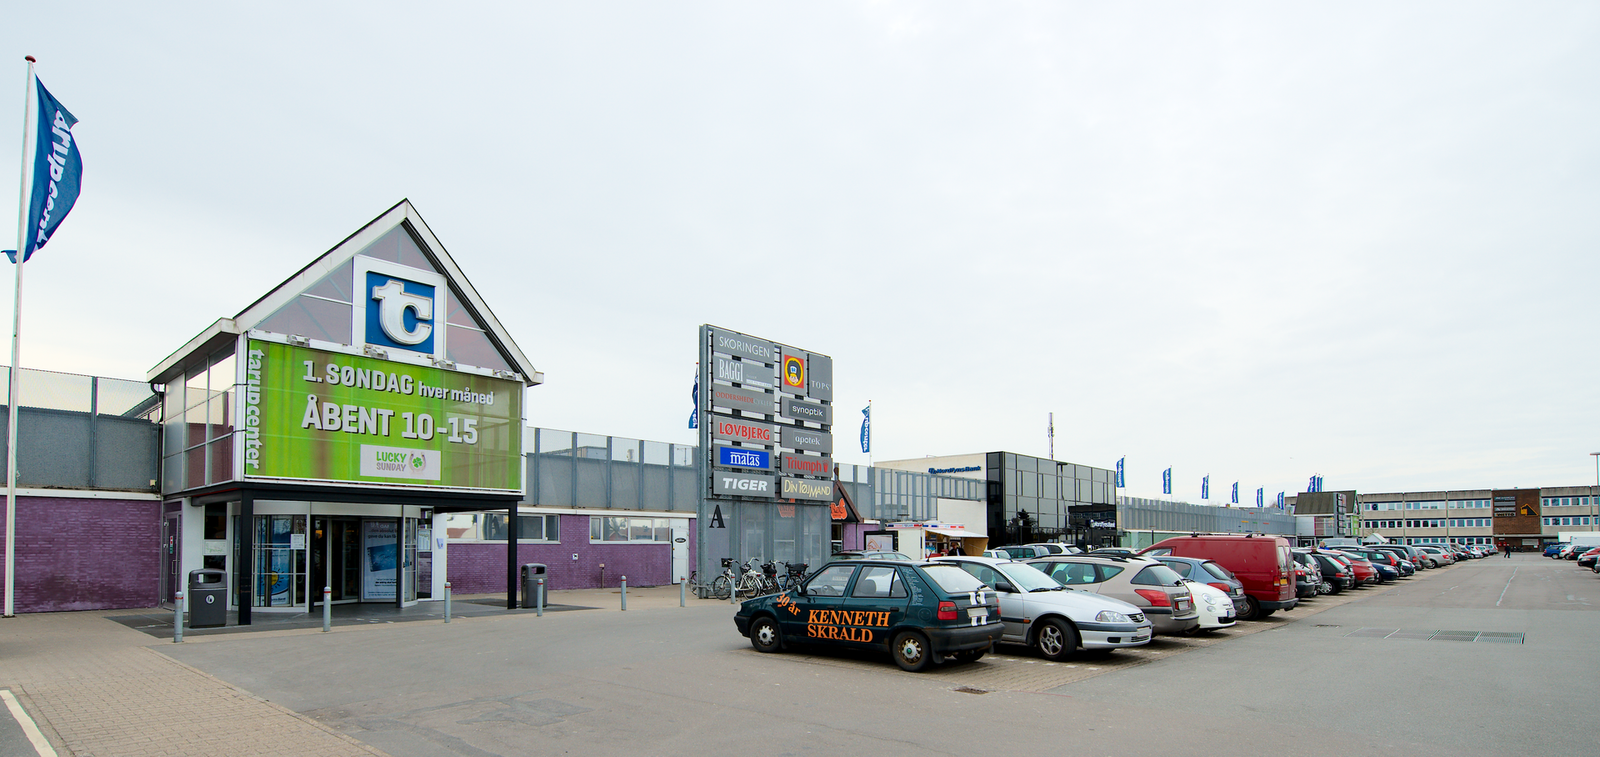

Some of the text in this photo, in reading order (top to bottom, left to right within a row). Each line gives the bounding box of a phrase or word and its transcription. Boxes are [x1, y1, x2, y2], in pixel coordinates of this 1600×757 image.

[719, 336, 770, 358] SKORINGEN
[719, 358, 744, 382] BAGGI
[303, 360, 494, 405] 1. SØNDAG hver måned
[246, 349, 265, 469] tarupcenter
[301, 394, 395, 437] ÅBENT
[792, 405, 824, 417] synoptik
[719, 422, 770, 441] LØVBJERG
[795, 435, 821, 446] apotek
[376, 451, 407, 463] LUCKY
[730, 451, 760, 467] matas
[785, 456, 822, 474] Triumph
[376, 462, 407, 472] SUNDAY
[722, 477, 768, 492] TIGER
[709, 504, 726, 529] A
[776, 593, 801, 616] 30 år
[807, 609, 891, 627] KENNETH
[807, 624, 874, 643] SKRALD
